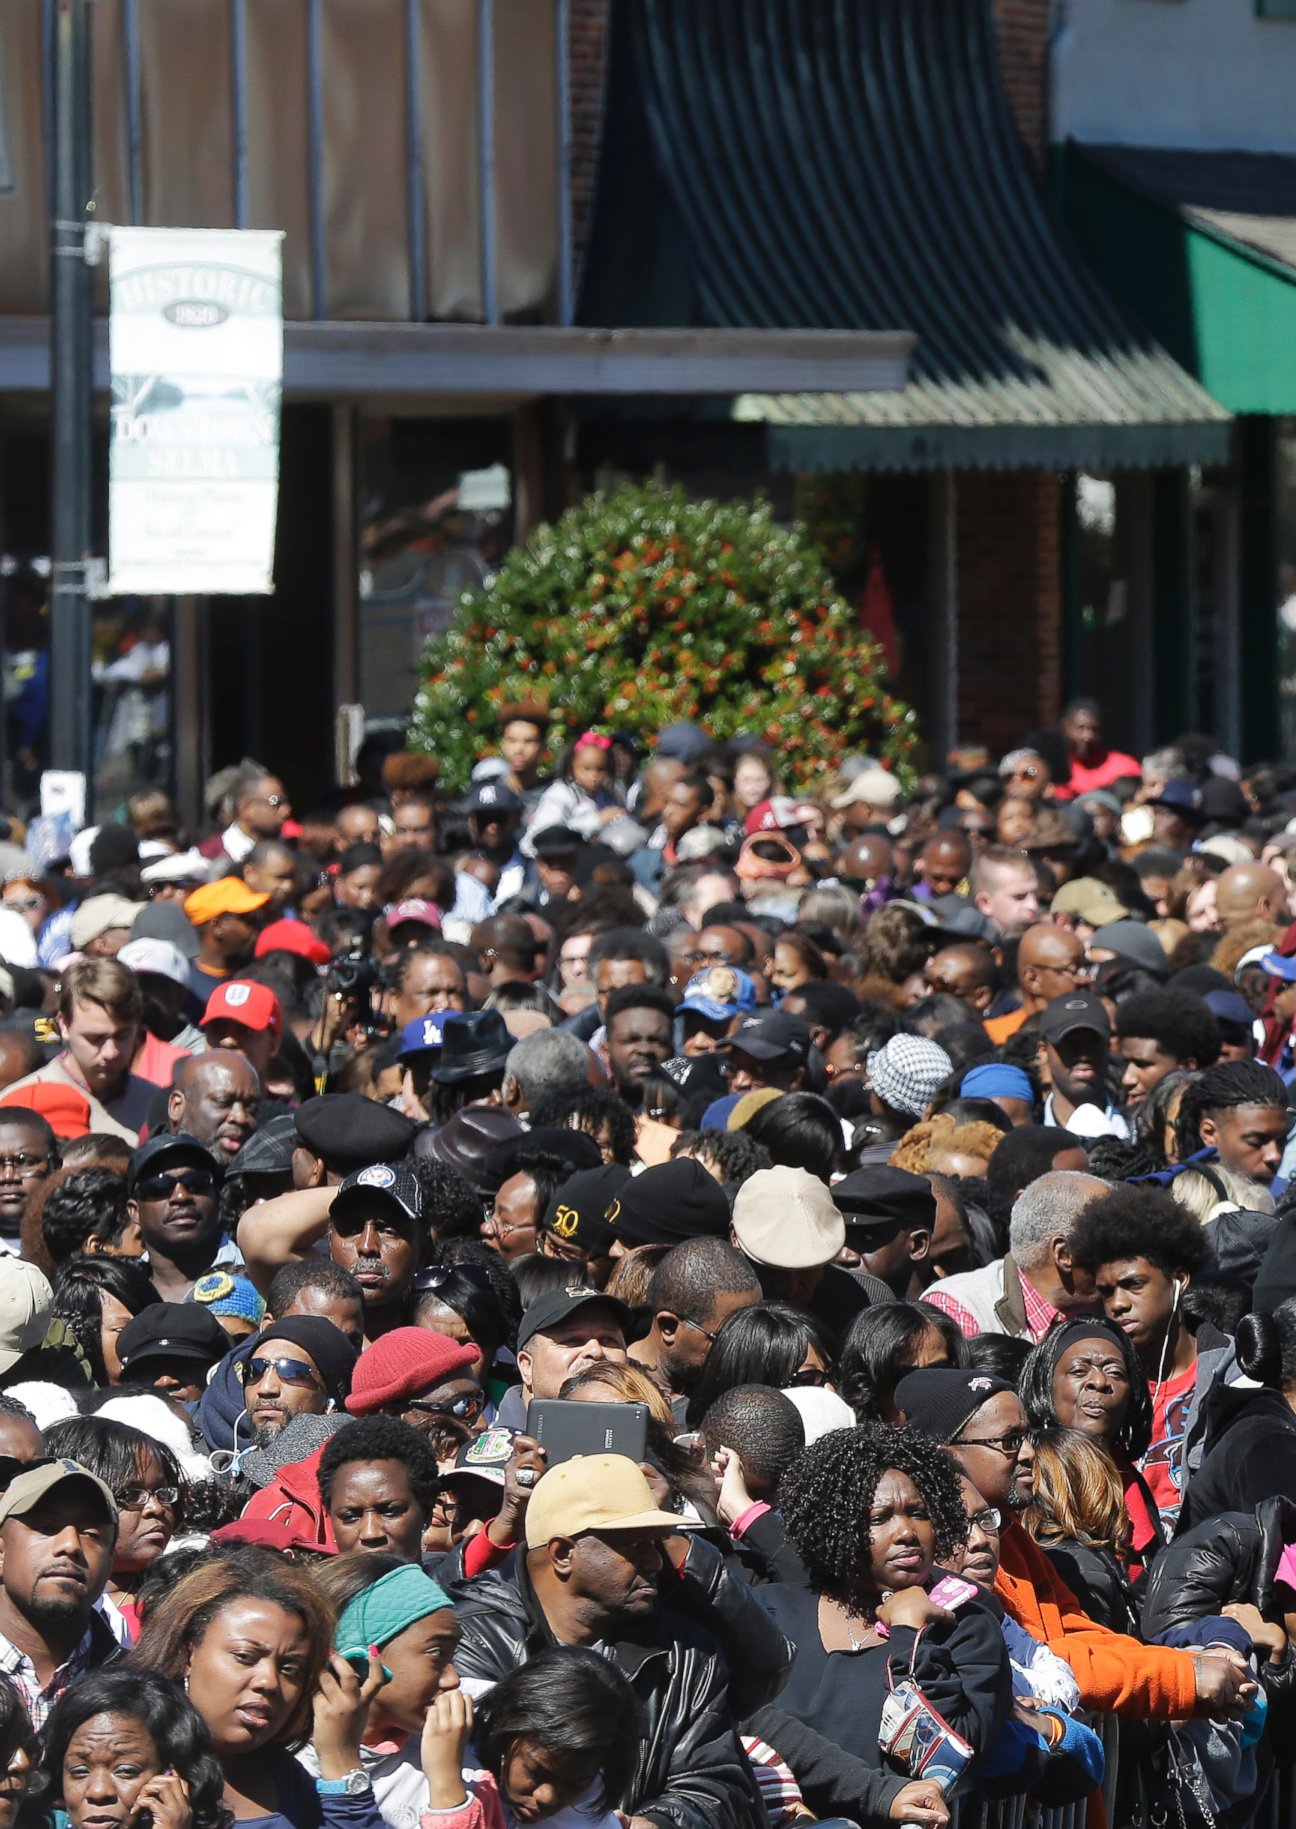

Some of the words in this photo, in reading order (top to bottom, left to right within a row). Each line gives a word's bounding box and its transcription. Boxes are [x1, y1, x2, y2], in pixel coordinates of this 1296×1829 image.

[118, 267, 273, 317] HISTORIC
[148, 448, 241, 476] SELMA
[553, 1205, 579, 1233] 50
